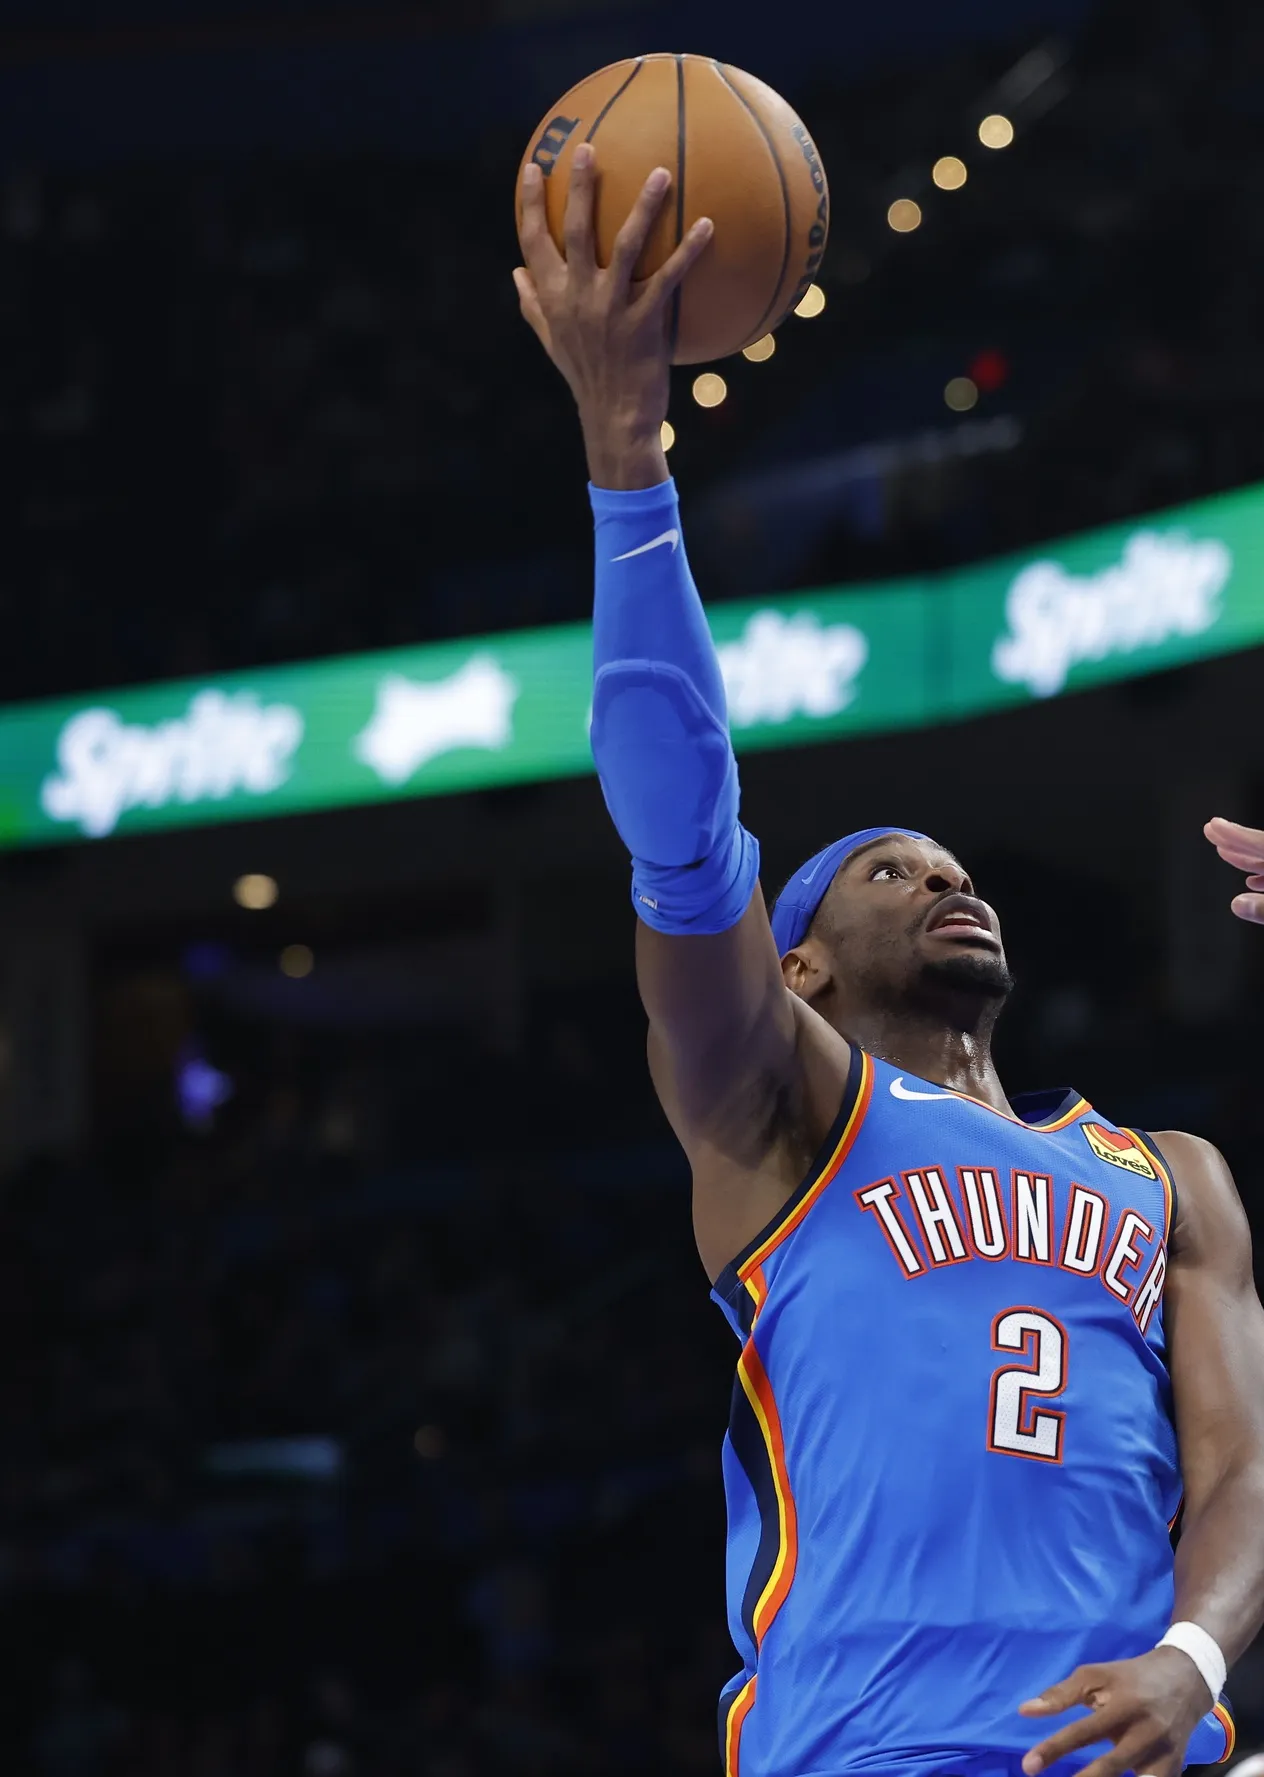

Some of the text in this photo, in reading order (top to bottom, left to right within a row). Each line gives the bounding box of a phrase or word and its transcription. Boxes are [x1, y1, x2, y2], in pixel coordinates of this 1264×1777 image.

[994, 530, 1230, 695] Sprite
[42, 692, 303, 835] Sprite
[853, 1164, 1167, 1337] THUNDER
[986, 1305, 1069, 1465] 2
